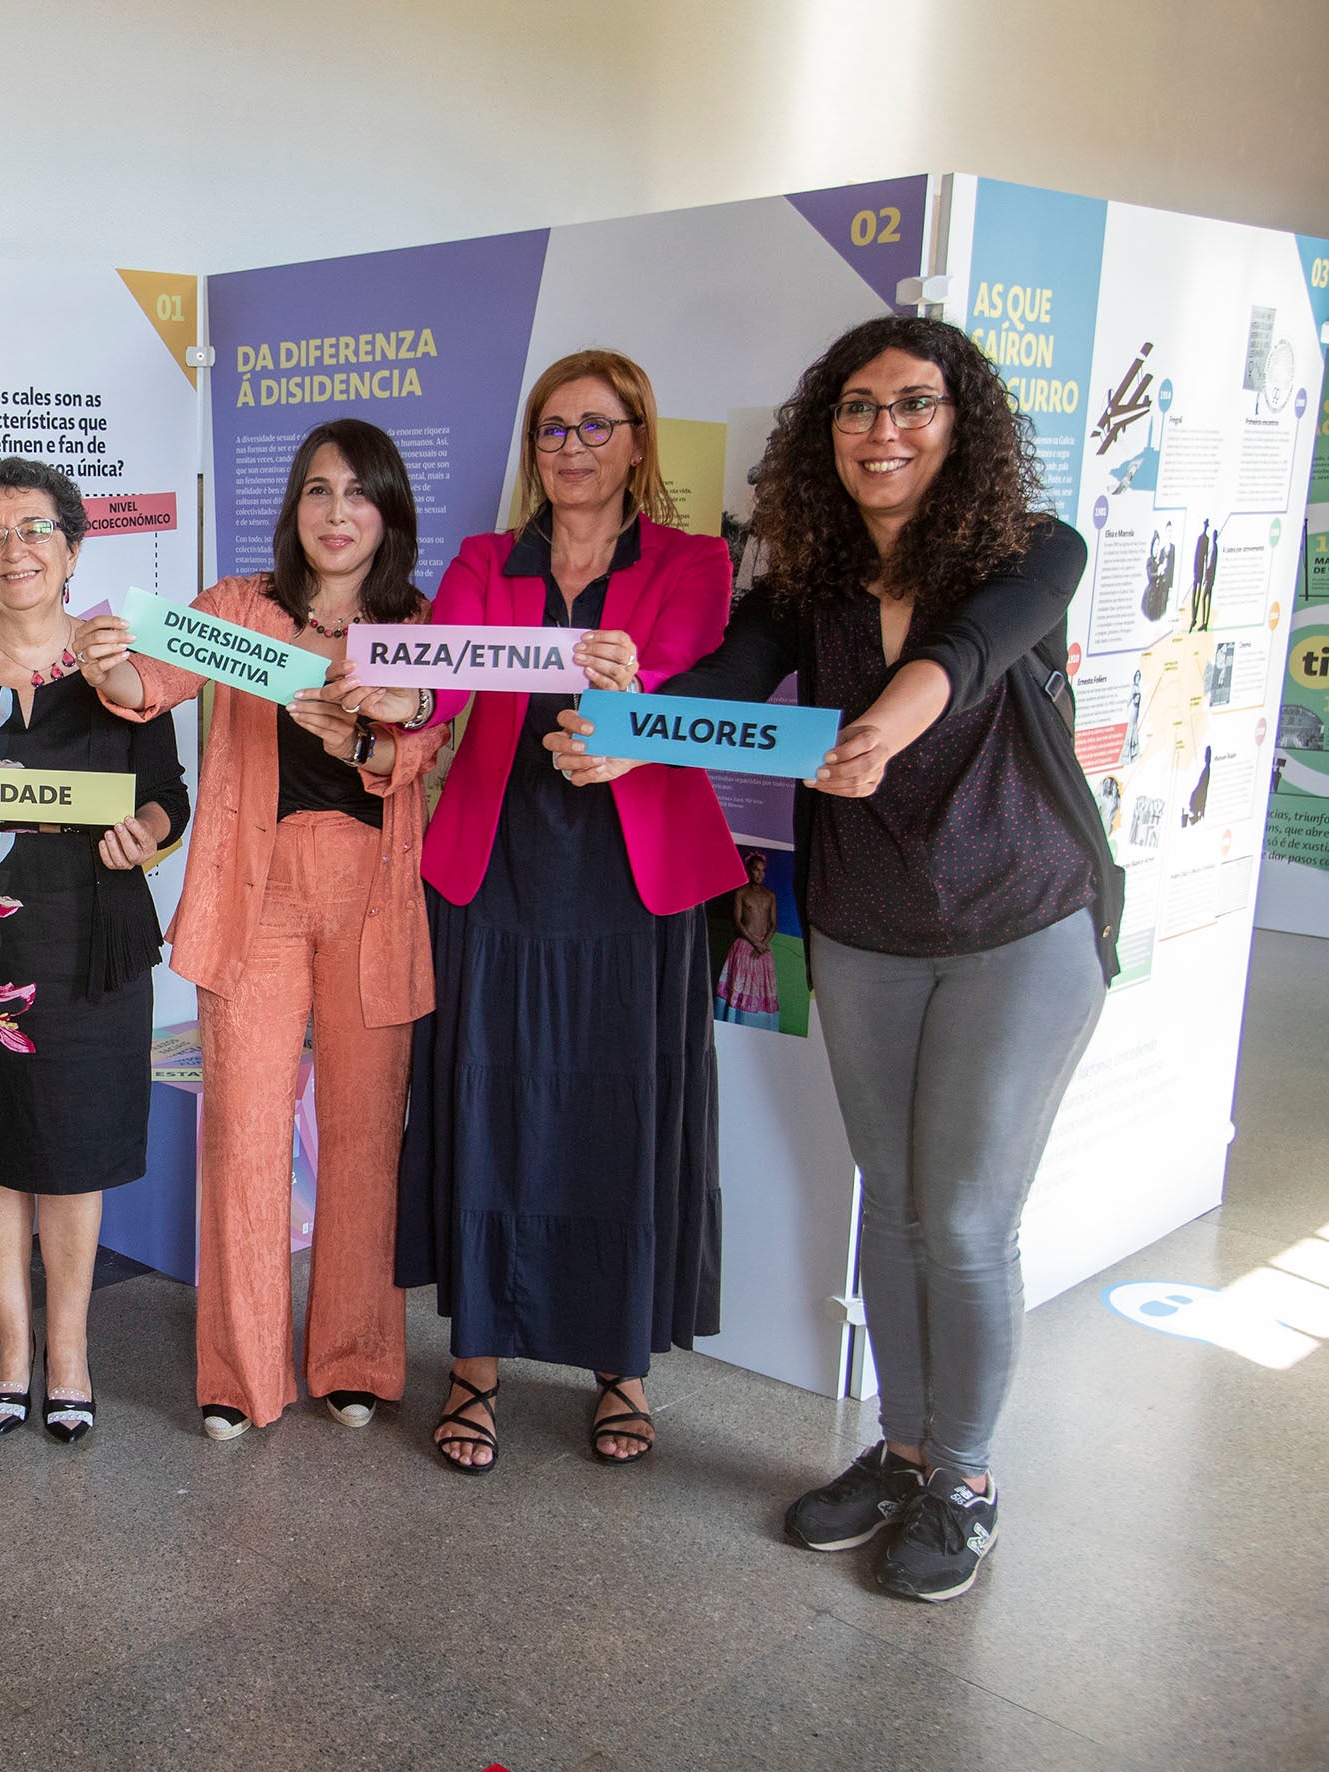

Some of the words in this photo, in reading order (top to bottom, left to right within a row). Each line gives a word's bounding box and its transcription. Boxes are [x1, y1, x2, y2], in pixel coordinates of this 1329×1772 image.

[850, 206, 901, 246] 02
[1311, 257, 1329, 288] 03
[157, 294, 185, 321] 01
[973, 282, 1004, 318] AS
[1007, 285, 1053, 331] QUE
[237, 343, 274, 373] DA
[279, 328, 437, 369] DIFERENZA
[12, 387, 51, 406] cales
[54, 392, 82, 407] son
[85, 394, 102, 407] as
[236, 373, 255, 408] Á
[260, 368, 422, 406] DISIDENCIA
[78, 417, 107, 436] que
[423, 426, 450, 436] riqueza
[46, 439, 56, 453] e
[58, 436, 85, 454] fan
[87, 436, 106, 454] de
[241, 435, 275, 443] diversidade
[276, 433, 295, 441] sexual
[48, 465, 74, 477] soa
[77, 459, 124, 477] única?
[109, 501, 138, 513] NIVEL
[85, 514, 171, 531] OCIOECONÓMICO
[164, 611, 289, 668] DIVERSIDADE
[166, 637, 269, 687] COGNITIVA
[370, 640, 565, 674] RAZA/ETNIA
[629, 711, 778, 750] VALORES
[1284, 826, 1303, 837] que
[1280, 837, 1286, 848] é
[1288, 838, 1301, 849] de
[1268, 850, 1286, 861] dar
[1287, 855, 1317, 865] pasos
